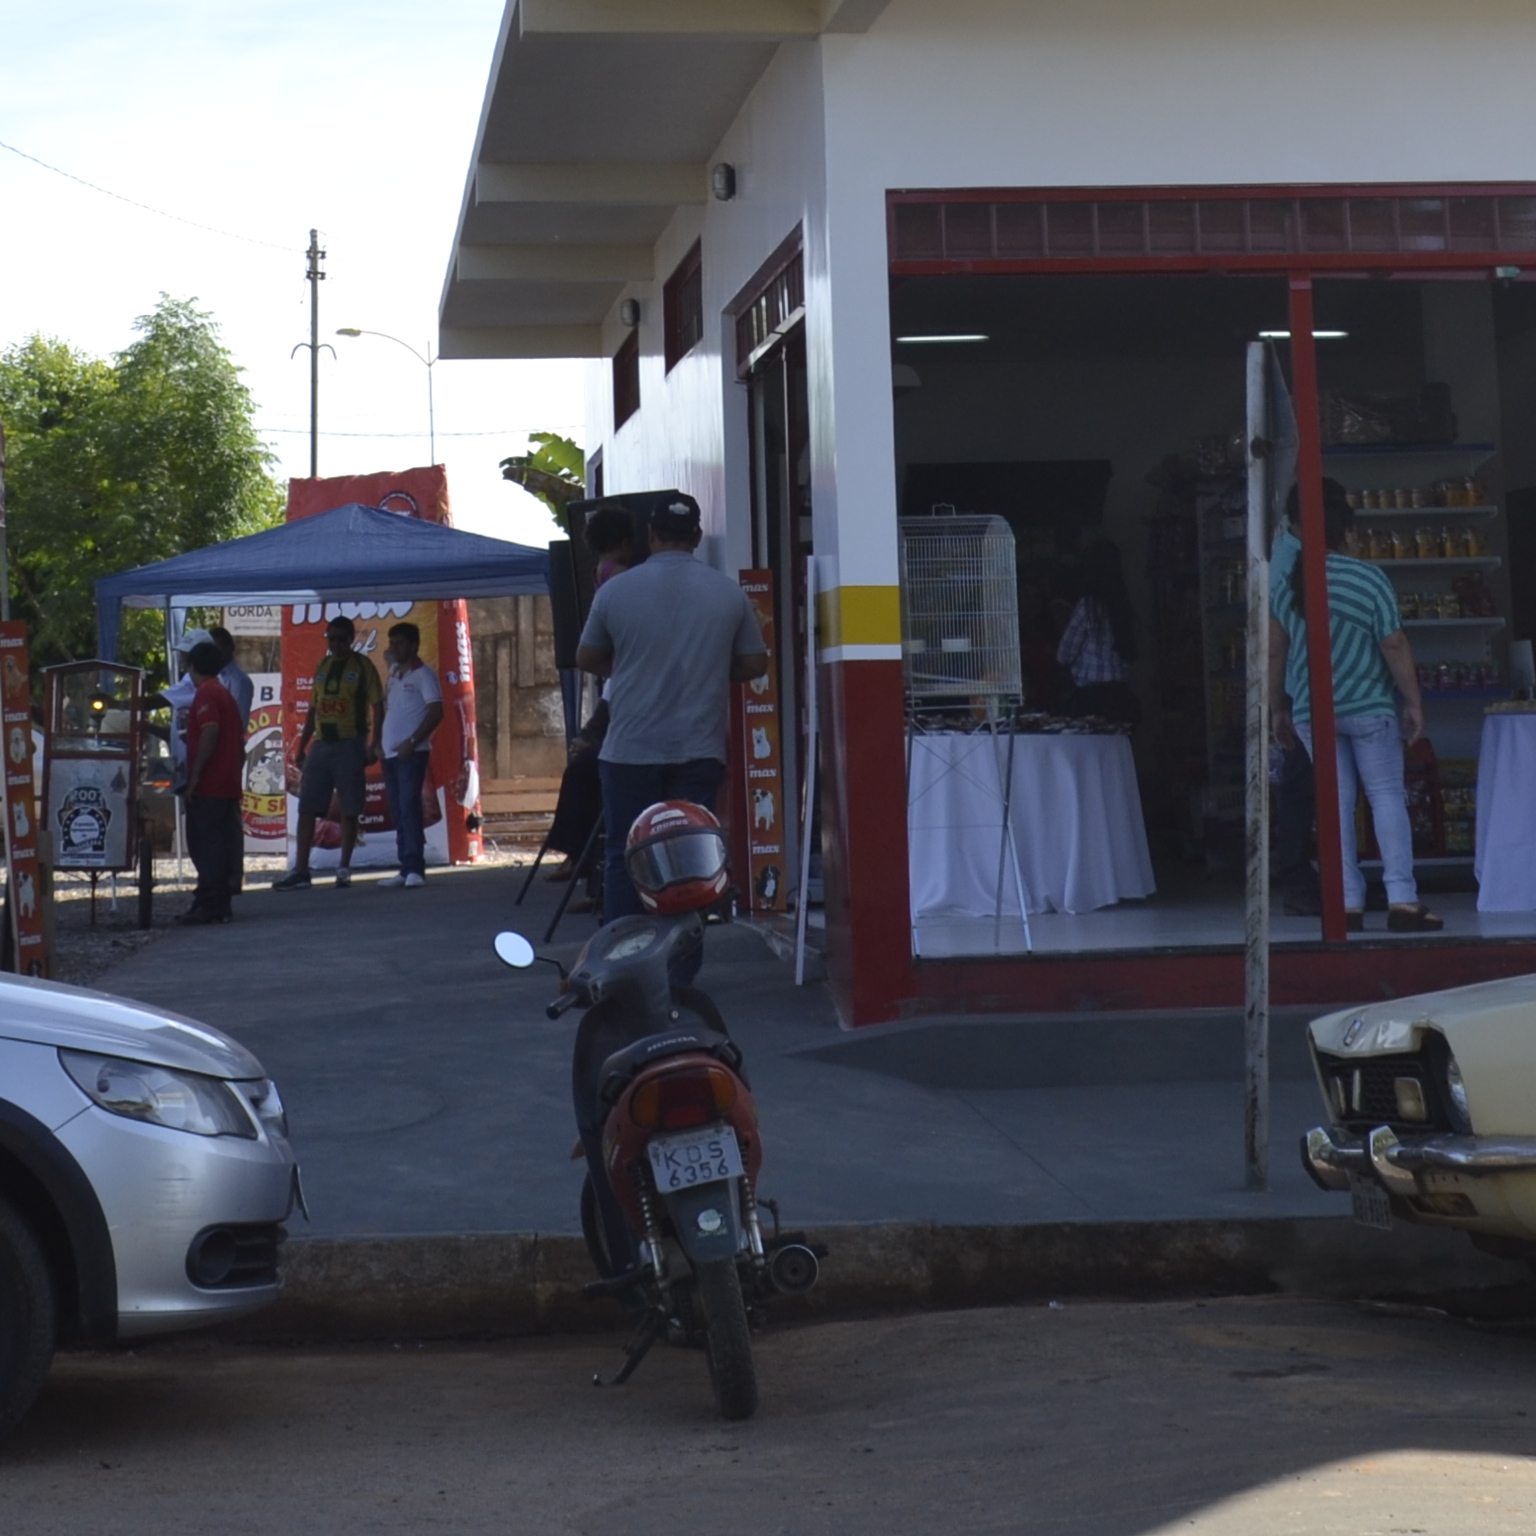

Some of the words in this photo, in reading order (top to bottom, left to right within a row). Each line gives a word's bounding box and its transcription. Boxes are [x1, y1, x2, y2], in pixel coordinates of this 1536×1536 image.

[747, 703, 774, 712] max
[750, 767, 776, 777] max
[753, 844, 779, 853] max
[648, 1036, 697, 1051] HONDA
[669, 1158, 728, 1187] 6356
